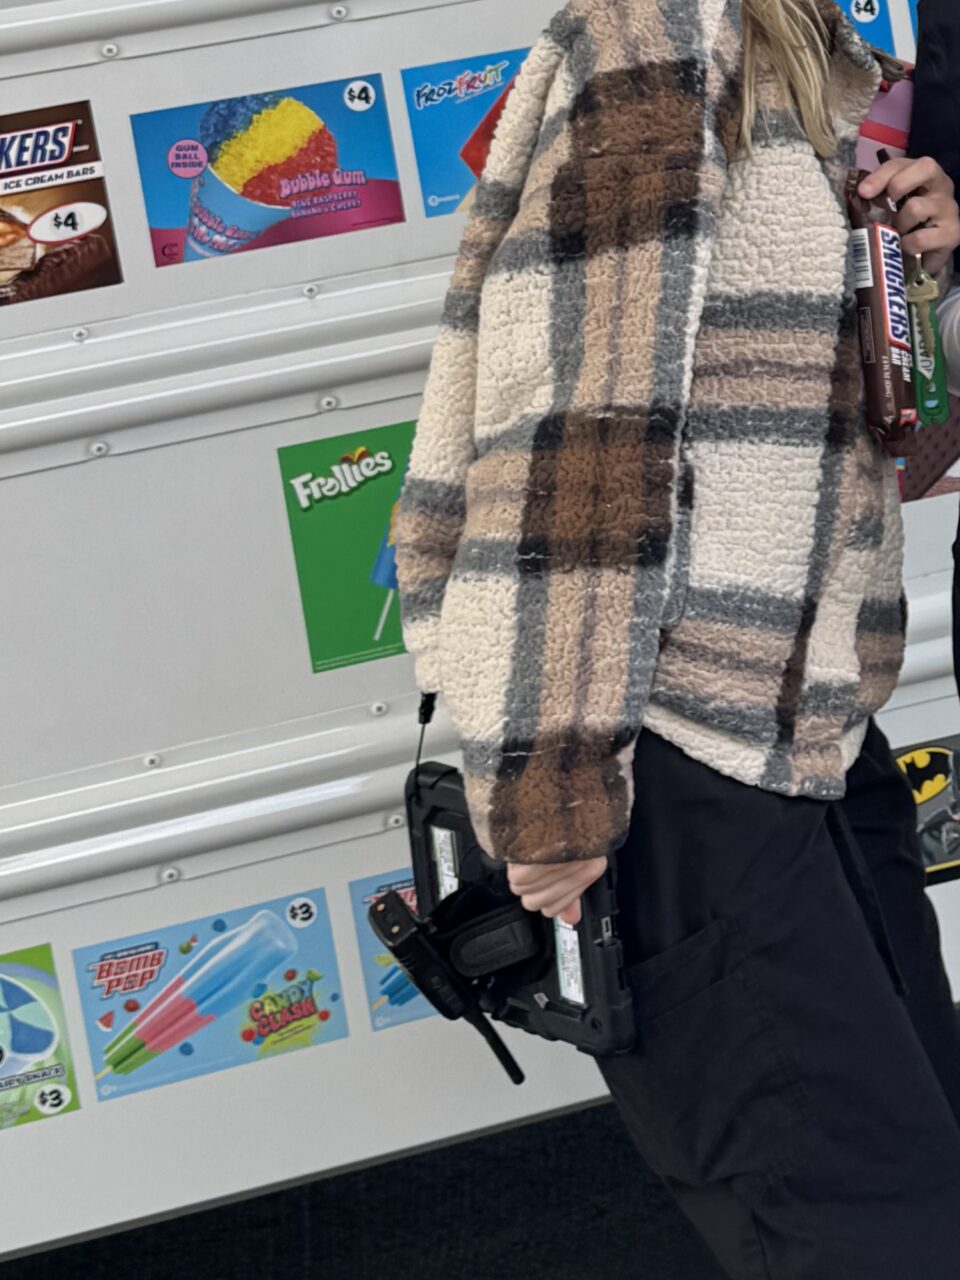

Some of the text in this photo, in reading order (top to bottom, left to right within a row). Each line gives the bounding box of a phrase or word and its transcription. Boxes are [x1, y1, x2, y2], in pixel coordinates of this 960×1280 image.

[347, 86, 372, 105] $4
[174, 153, 200, 161] BALL
[175, 144, 199, 152] GUM
[171, 161, 204, 169] INSIDE
[3, 166, 96, 190] ICE CREAM BARS
[279, 168, 367, 198] Bubble Gum
[53, 211, 78, 231] $4
[880, 228, 910, 342] SNICKERS
[290, 450, 393, 510] Frollies
[288, 902, 316, 922] $3
[95, 950, 164, 983] BOMB
[103, 969, 156, 997] POP
[250, 978, 315, 1022] CANDY
[39, 1089, 64, 1108] $3
